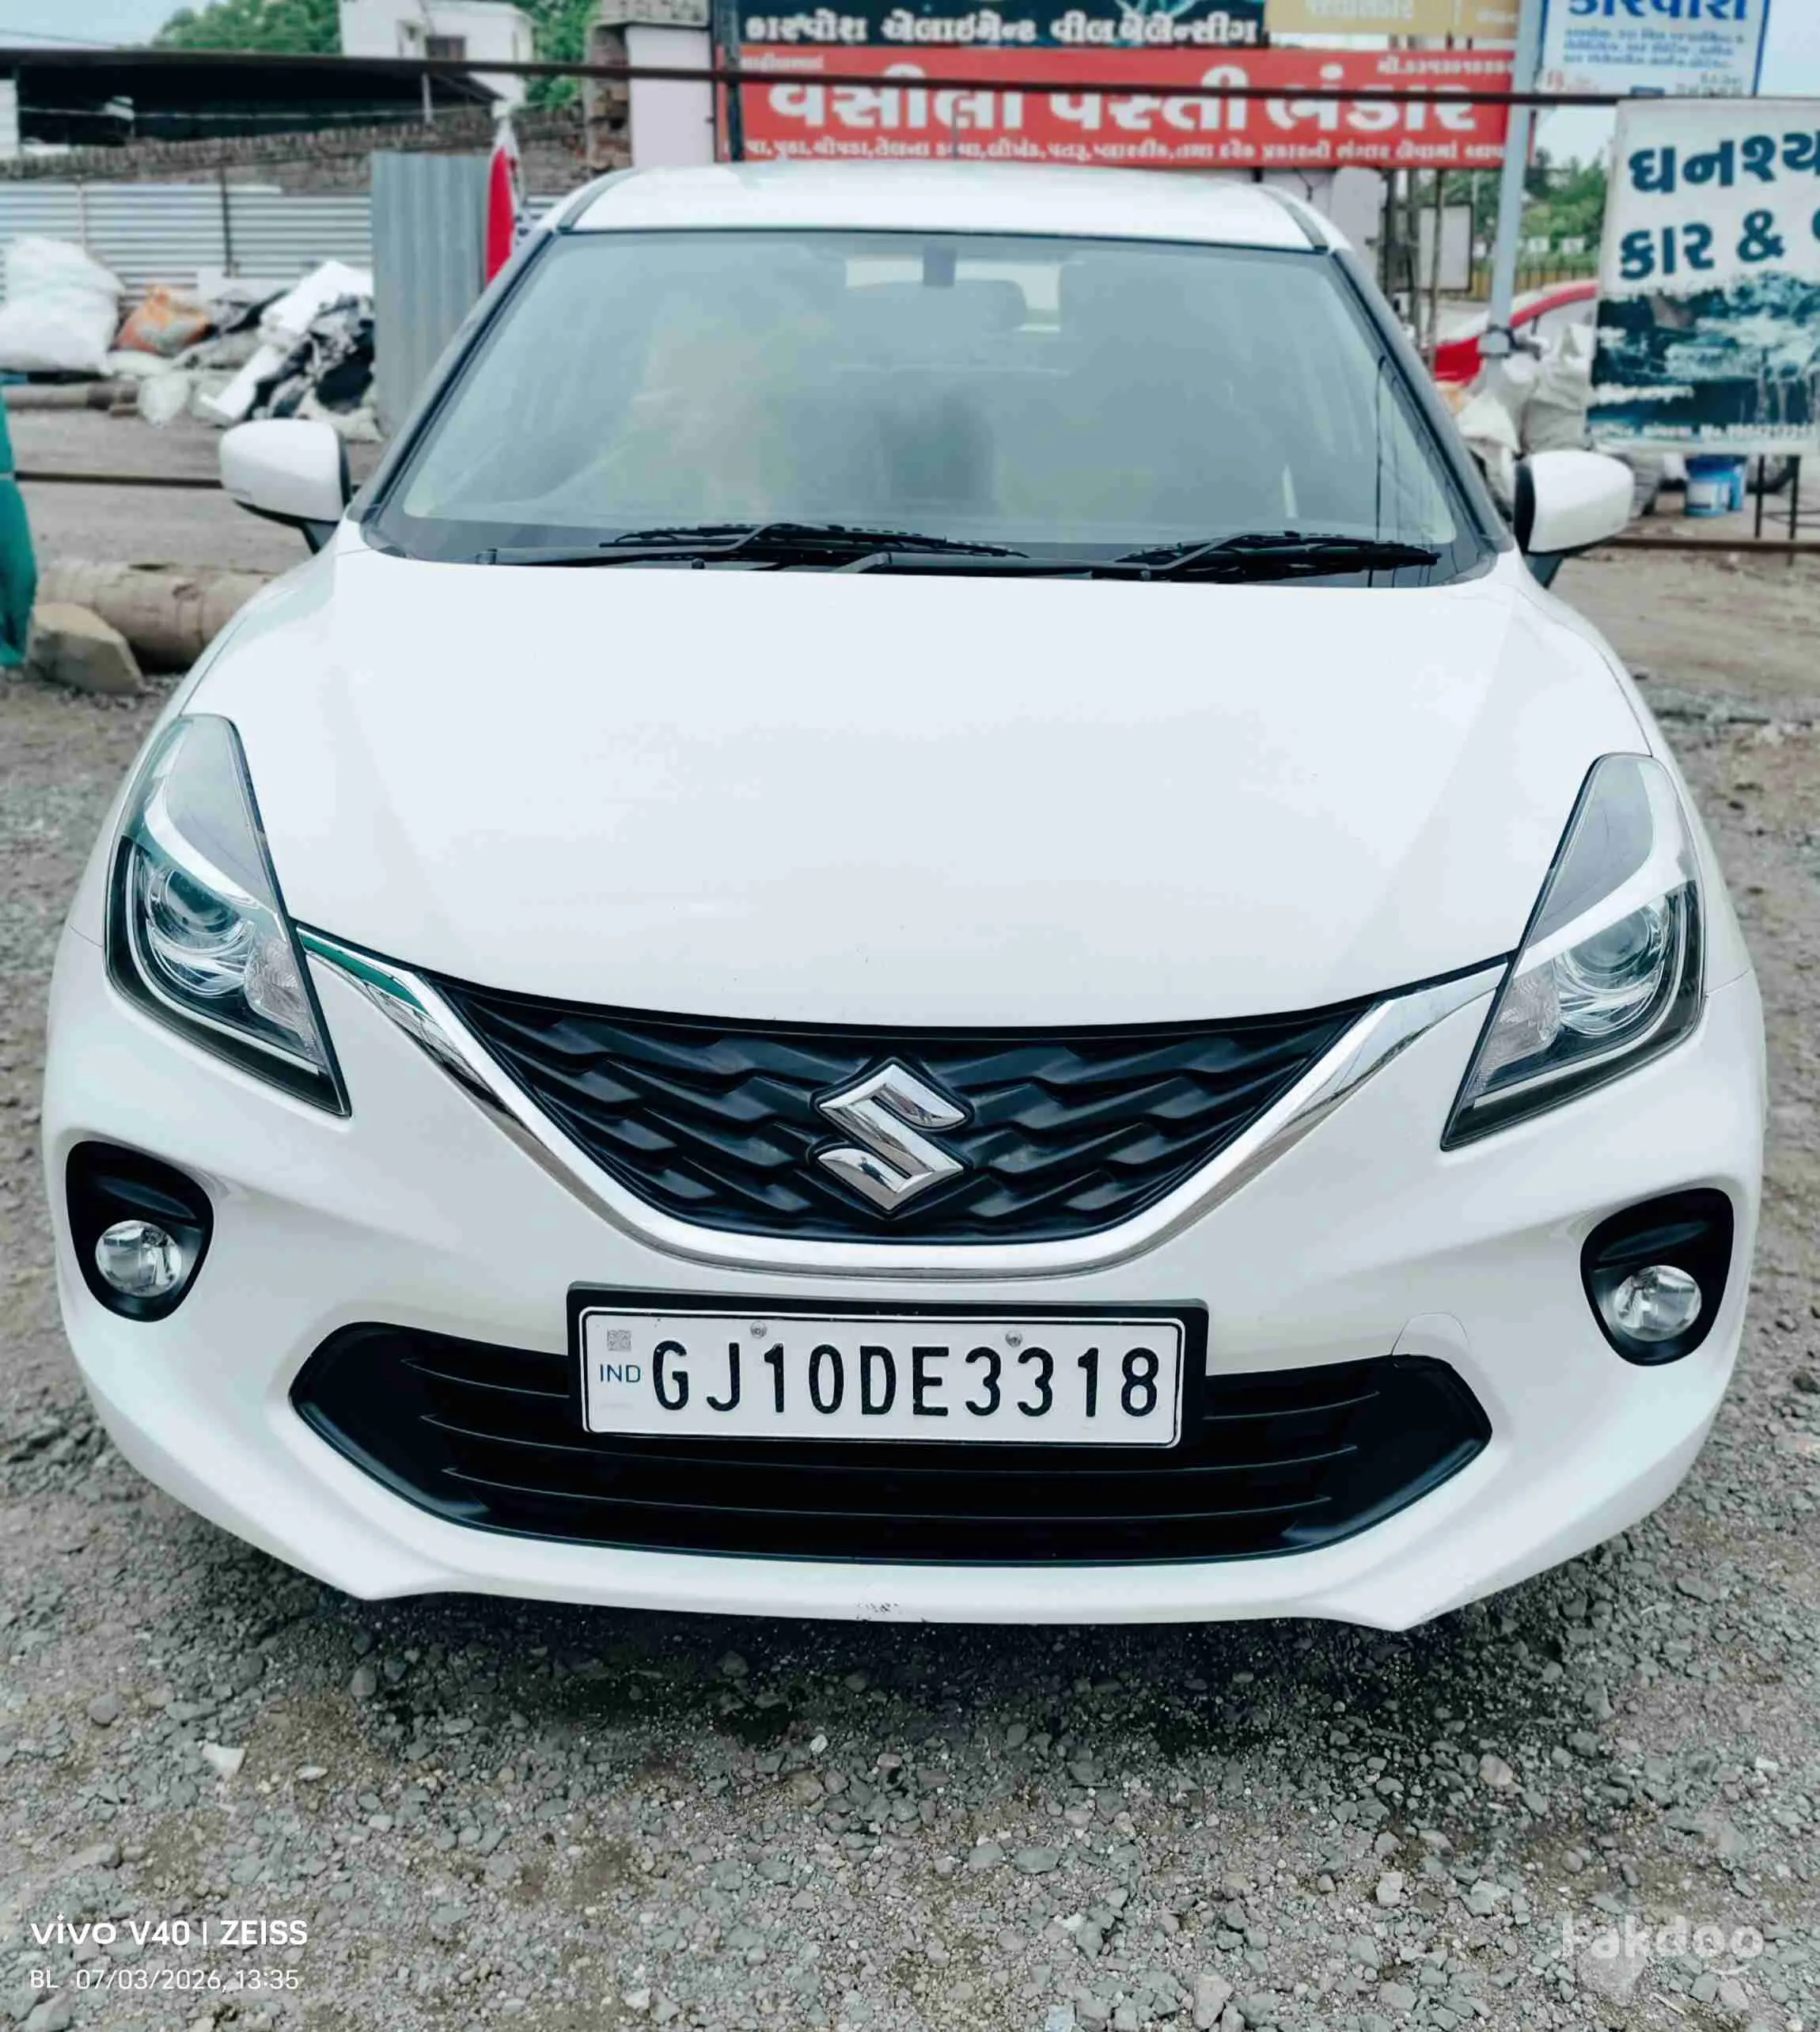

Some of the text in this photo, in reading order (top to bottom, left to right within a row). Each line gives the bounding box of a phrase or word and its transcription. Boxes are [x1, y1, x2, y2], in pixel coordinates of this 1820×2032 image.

[1619, 209, 1786, 281] કાર &
[600, 1340, 1159, 1418] IND GJ10DE3318
